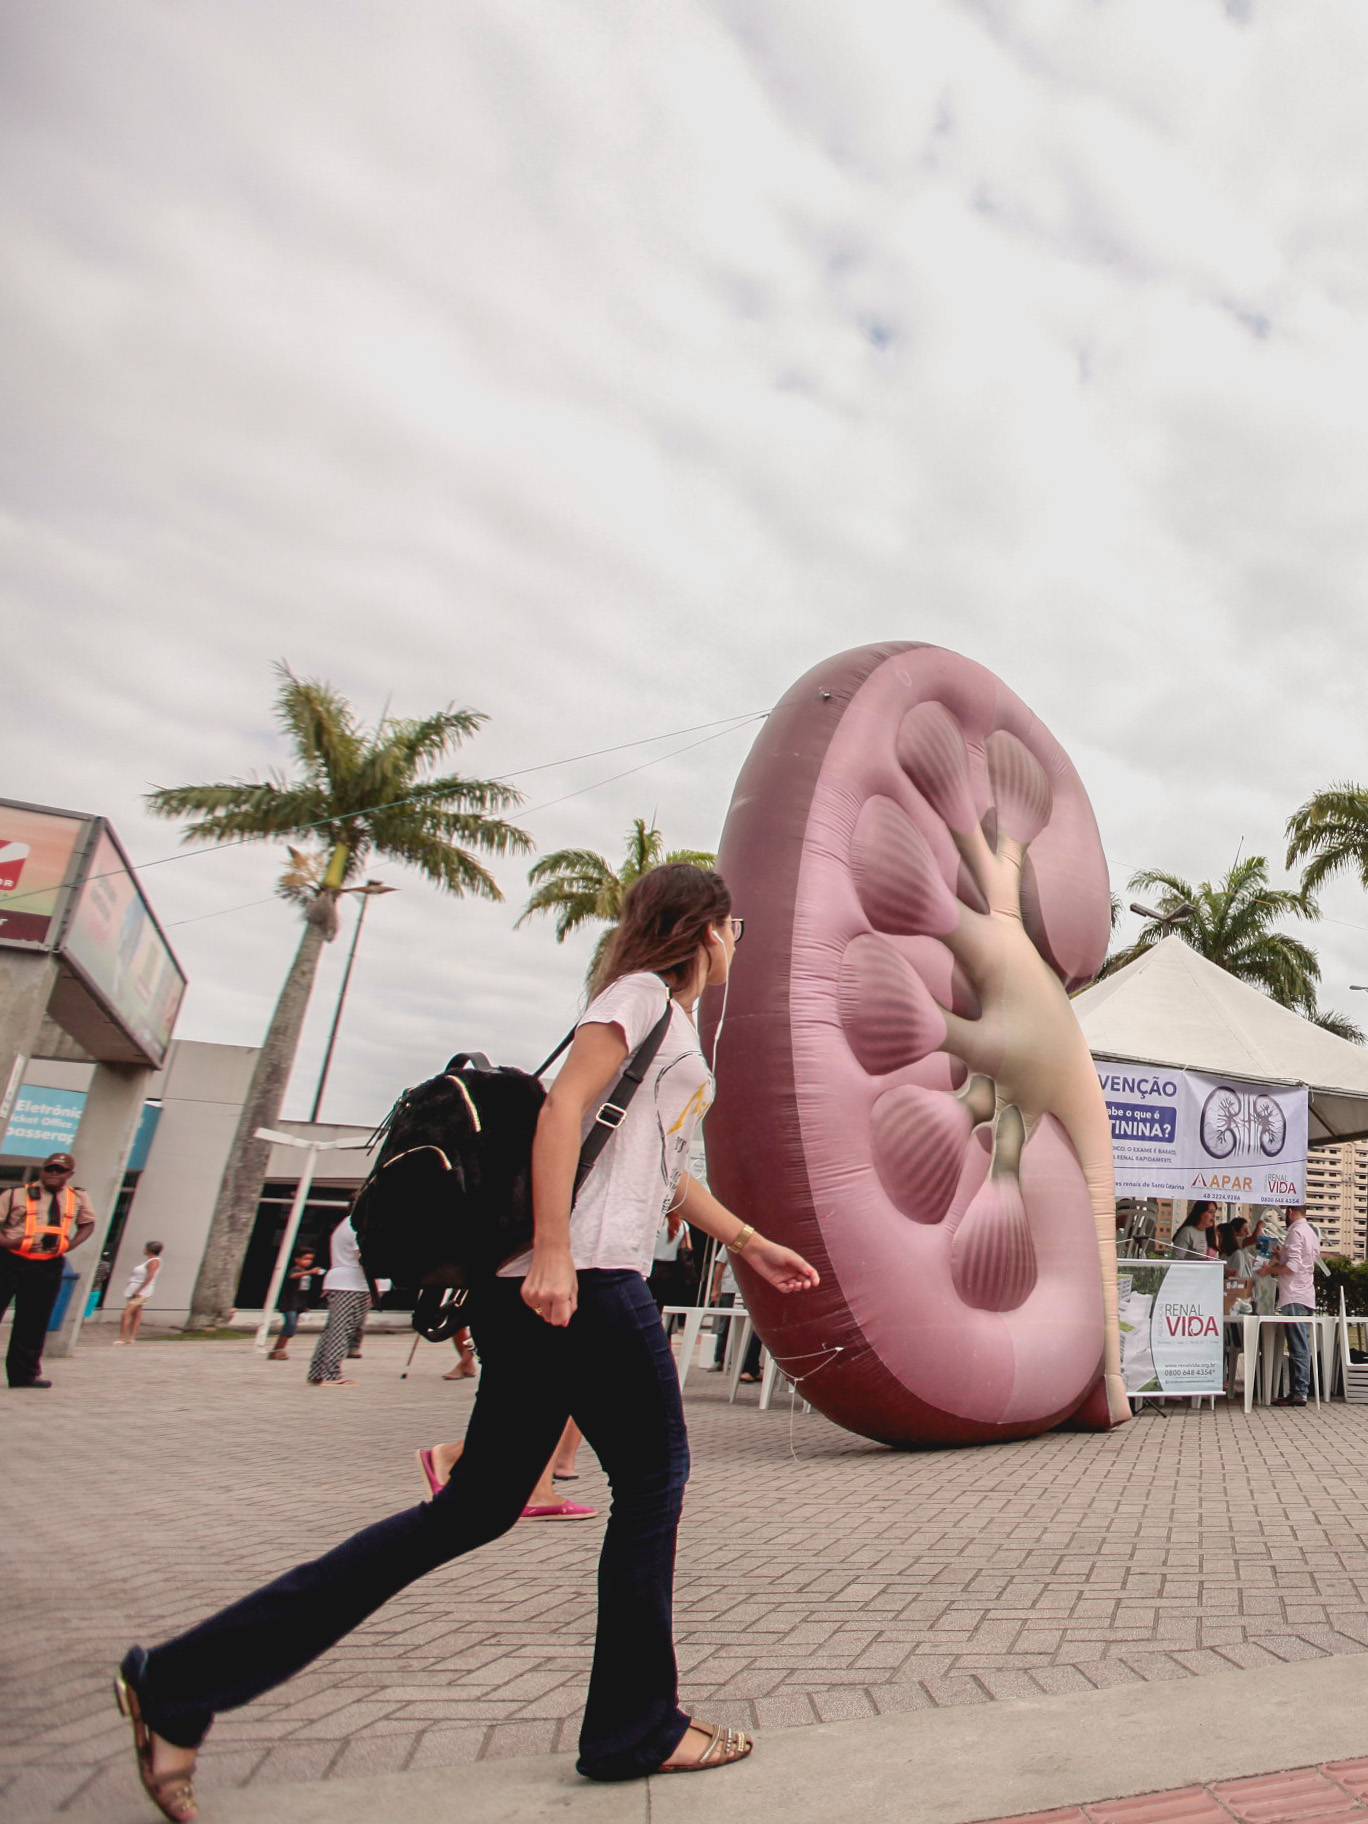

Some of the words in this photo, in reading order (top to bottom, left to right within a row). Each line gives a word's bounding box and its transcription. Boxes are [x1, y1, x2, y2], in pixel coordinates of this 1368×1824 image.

[1134, 1111, 1152, 1120] que
[1153, 1110, 1160, 1120] é
[1209, 1174, 1253, 1190] APAR
[1267, 1173, 1288, 1182] RENAL
[1268, 1181, 1297, 1194] VIDA
[1165, 1303, 1204, 1316] RENAL
[1165, 1316, 1219, 1336] VIDA
